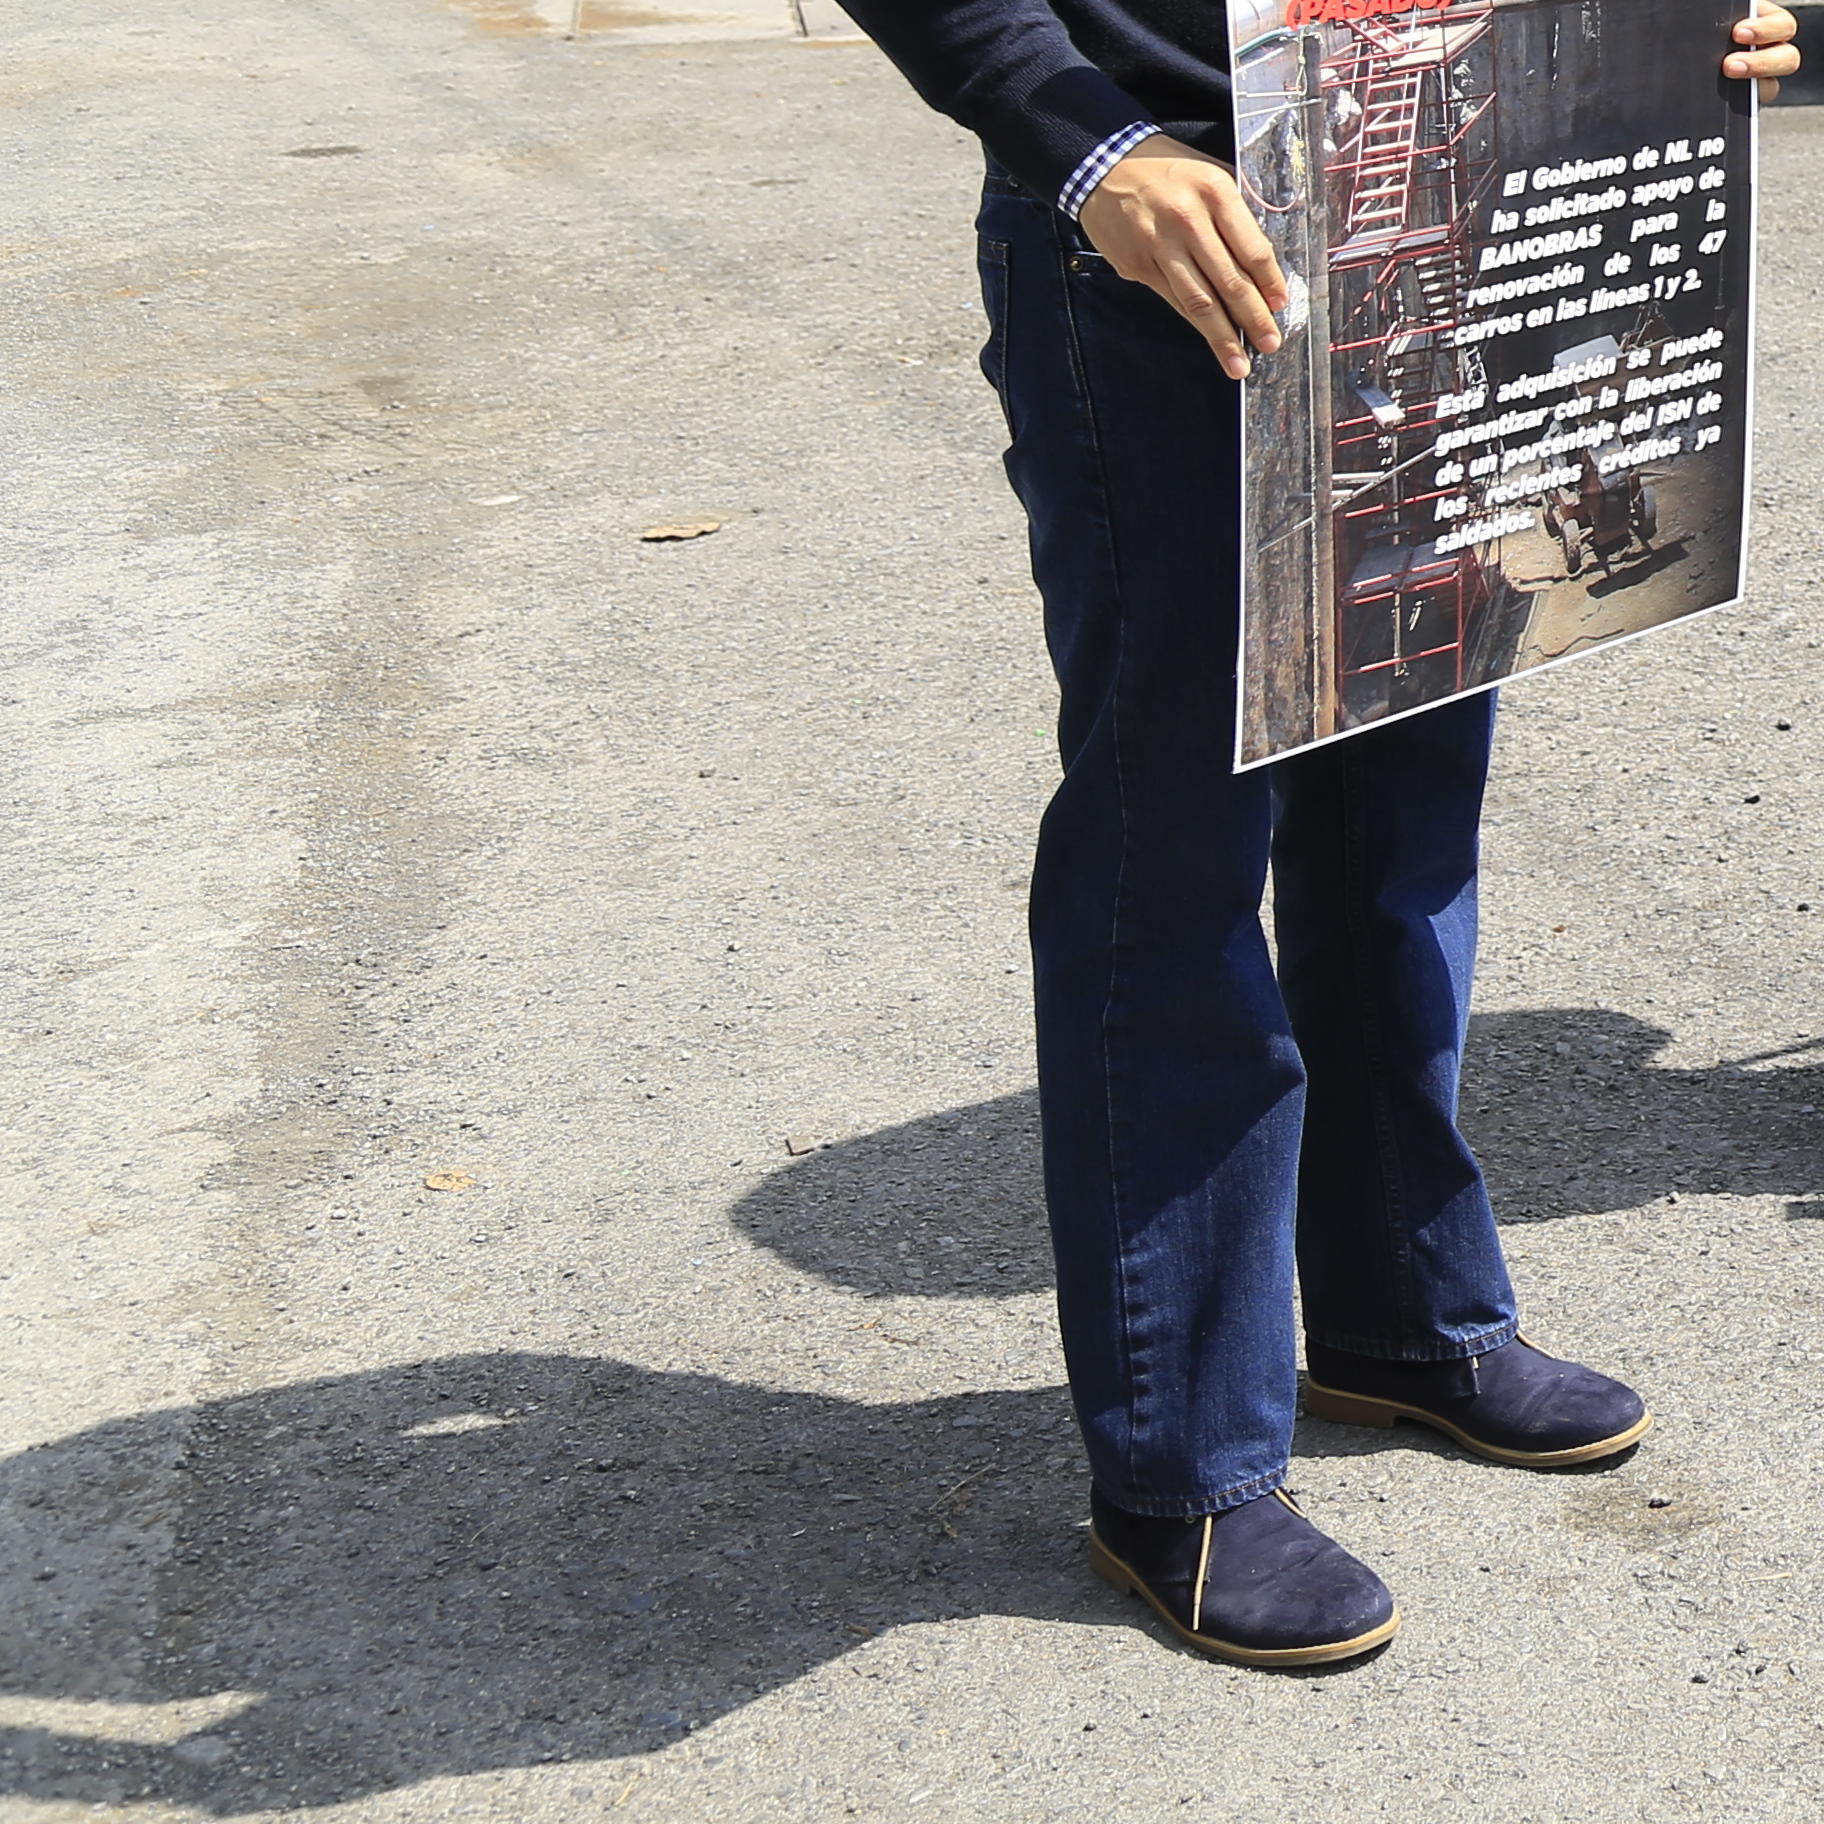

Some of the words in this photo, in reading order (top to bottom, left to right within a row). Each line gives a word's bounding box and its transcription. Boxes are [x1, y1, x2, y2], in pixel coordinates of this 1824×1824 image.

[1523, 185, 1628, 228] solicitado
[1630, 174, 1695, 208] apoyo
[1531, 155, 1628, 191] Gobierno
[1465, 261, 1586, 310] renovación
[1648, 242, 1682, 268] los
[1697, 228, 1728, 256] 47
[1478, 222, 1604, 272] BANOBRAS
[1629, 211, 1679, 244] para
[1453, 312, 1525, 347] carros
[1554, 296, 1589, 323] las
[1588, 282, 1651, 315] líneas
[1433, 405, 1549, 458] garantizar
[1552, 394, 1594, 425] con
[1623, 358, 1724, 404] liberación
[1434, 382, 1487, 420] Está
[1495, 352, 1618, 404] adquisición
[1659, 326, 1724, 367] puede
[1500, 418, 1617, 475] porcentaje
[1619, 405, 1655, 437] del
[1655, 395, 1694, 427] ISN
[1433, 494, 1469, 523] los
[1483, 462, 1584, 508] recientes
[1597, 435, 1683, 475] créditos
[1433, 504, 1537, 556] saldados.
